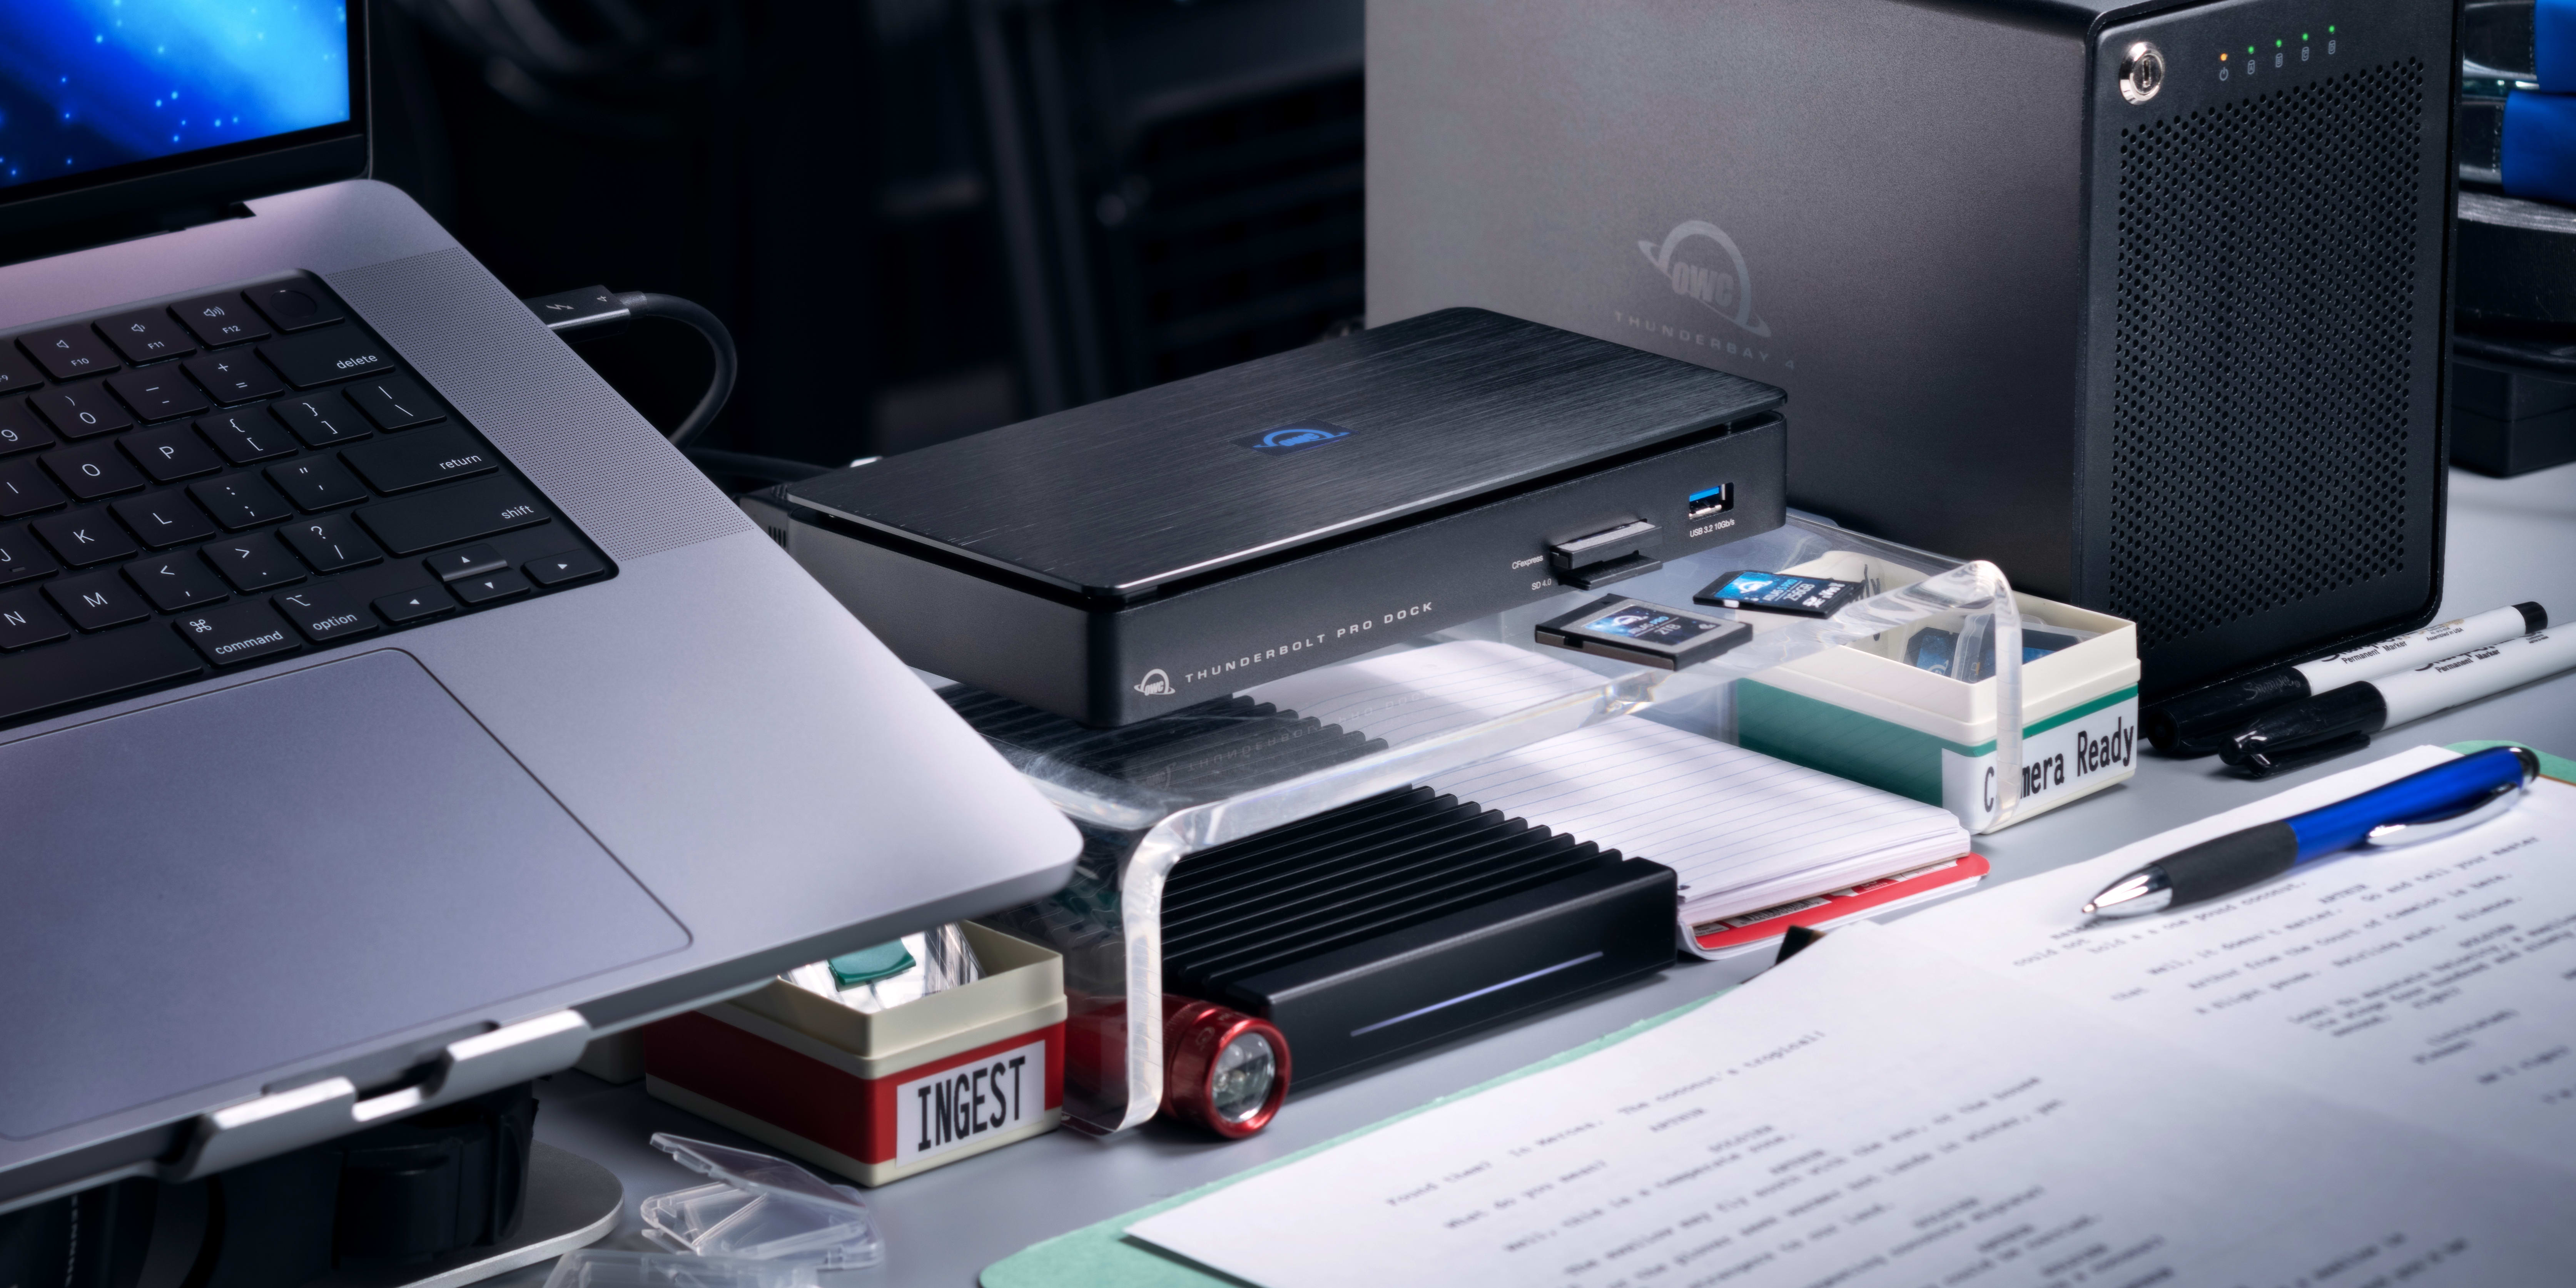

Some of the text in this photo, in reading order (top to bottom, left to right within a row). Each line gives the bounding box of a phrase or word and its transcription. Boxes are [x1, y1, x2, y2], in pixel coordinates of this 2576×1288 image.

[1671, 261, 1735, 308] OWC
[1615, 311, 1769, 363] THUNDERBAY
[71, 358, 89, 366] F10
[337, 355, 378, 369] delete
[1, 430, 18, 442] 9
[159, 446, 174, 459] P
[439, 455, 482, 470] return
[152, 513, 172, 525] L
[501, 505, 534, 519] shift
[1689, 518, 1735, 538] USB 3.2 10Gb/s
[73, 529, 95, 543] K
[1511, 554, 1544, 570] CFexpress
[1531, 578, 1552, 590] SD 4.0
[83, 592, 108, 607] M
[1782, 584, 1816, 601] 256GB
[3, 611, 26, 626] N
[313, 614, 357, 630] option
[1654, 623, 1682, 635] 2TB
[2426, 631, 2450, 642] Assembled
[215, 631, 283, 654] command
[1185, 601, 1433, 683] THUNDERBOLT PRO DOCK
[2341, 648, 2381, 664] Permanent
[2382, 640, 2408, 652] Marker
[2434, 657, 2474, 673] Permanent
[2474, 649, 2501, 661] Marker
[1144, 680, 1164, 696] OWC
[1984, 716, 2134, 813] Cmera Ready
[917, 1055, 1026, 1153] INGEST
